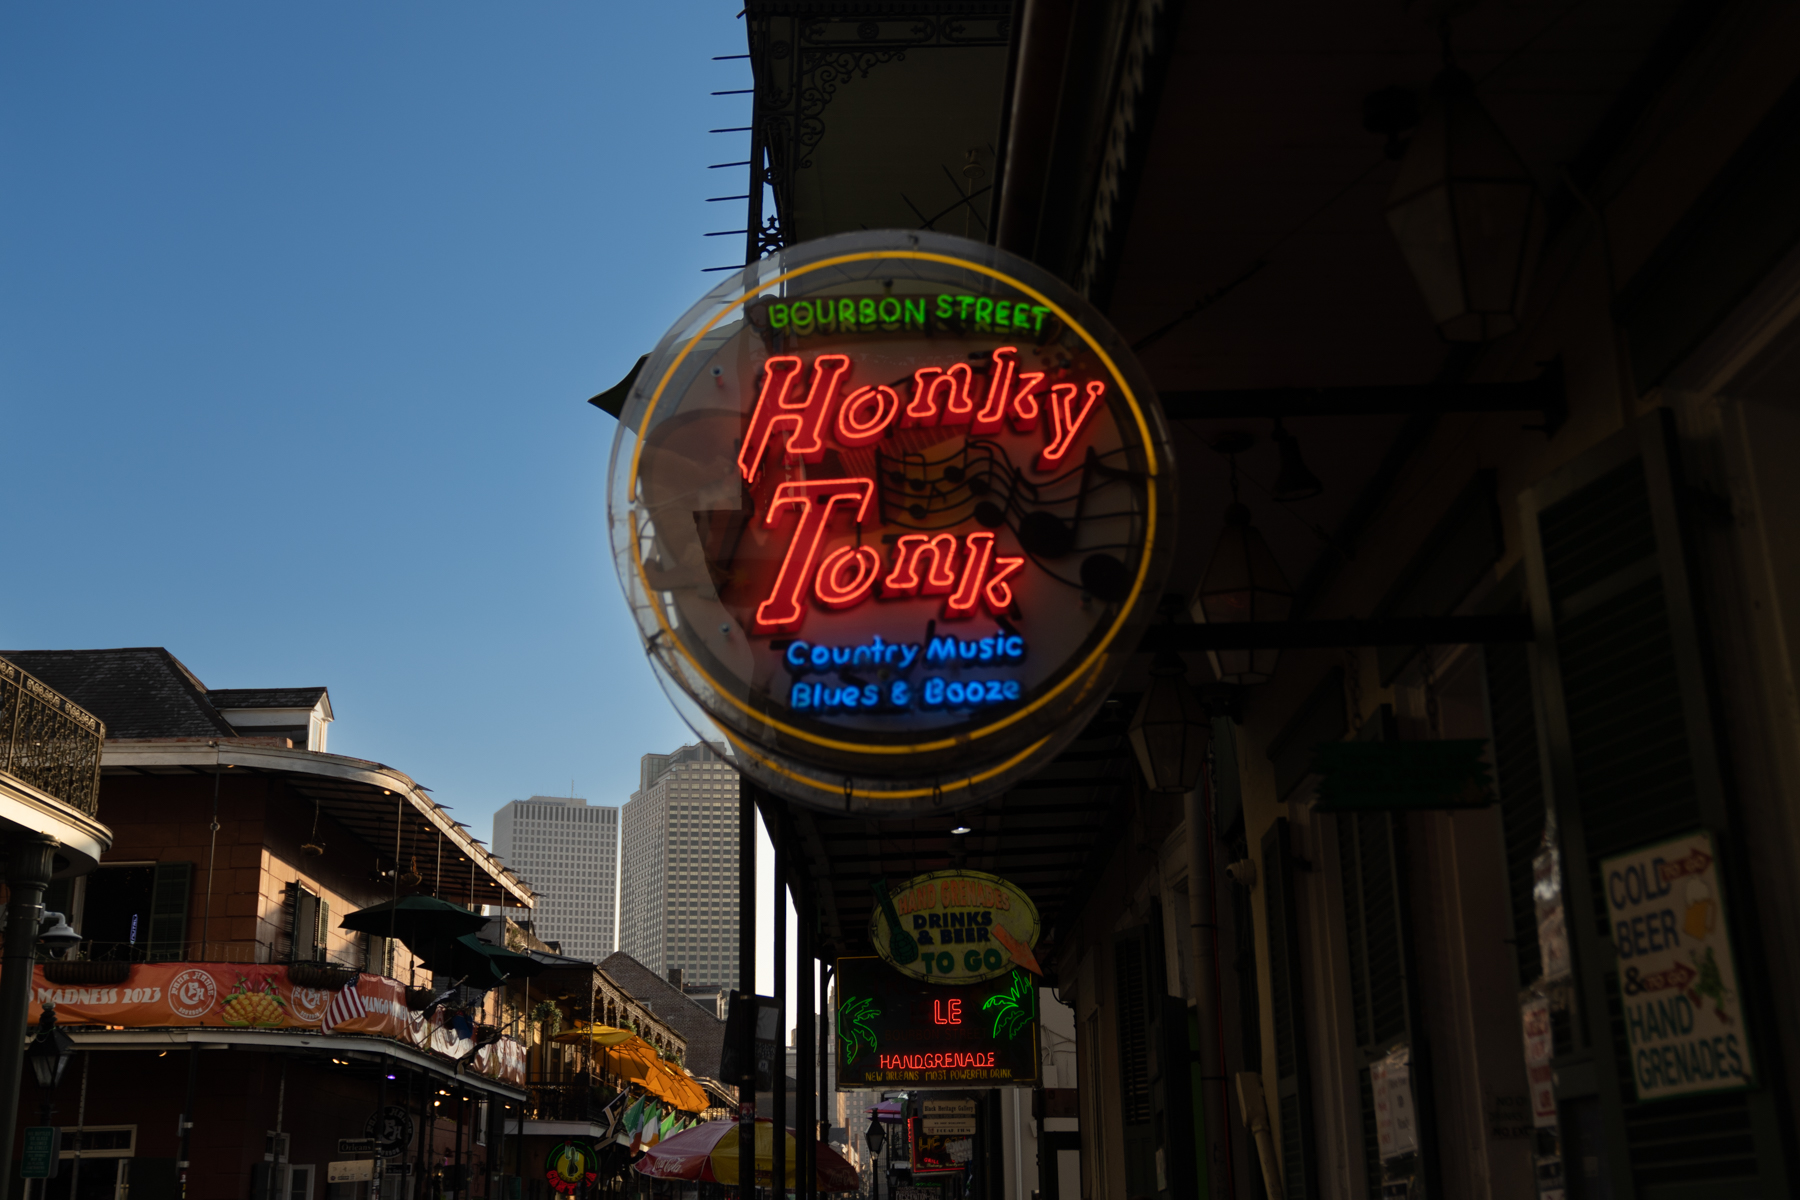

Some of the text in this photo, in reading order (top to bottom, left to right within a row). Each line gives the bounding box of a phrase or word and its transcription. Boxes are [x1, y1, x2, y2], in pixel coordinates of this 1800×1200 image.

[768, 293, 1052, 333] BOURBON STREET
[737, 345, 1106, 484] Honky
[755, 476, 1026, 628] Tonk
[786, 630, 1023, 668] Country Music
[790, 677, 1021, 708] Blues & Booze
[1659, 852, 1706, 881] TO GO
[898, 879, 1010, 916] HAND GRENADES
[1609, 857, 1671, 911] COLD
[913, 911, 993, 929] DRINKS
[916, 926, 991, 945] & BEER
[1616, 908, 1681, 960] BEER
[921, 947, 1003, 975] TO GO
[37, 988, 121, 1005] MADNESS
[122, 987, 162, 1004] 2023
[1624, 966, 1648, 997] &
[1629, 995, 1694, 1045] HAND
[865, 1068, 1013, 1082] NEW ORLEANS MOST POWERFUL DRINK
[879, 1052, 995, 1070] HANDGRENADE
[1636, 1037, 1743, 1091] GRENADES
[938, 1105, 956, 1113] Heritage
[958, 1105, 974, 1113] Gallery
[341, 1143, 372, 1152] Orleans
